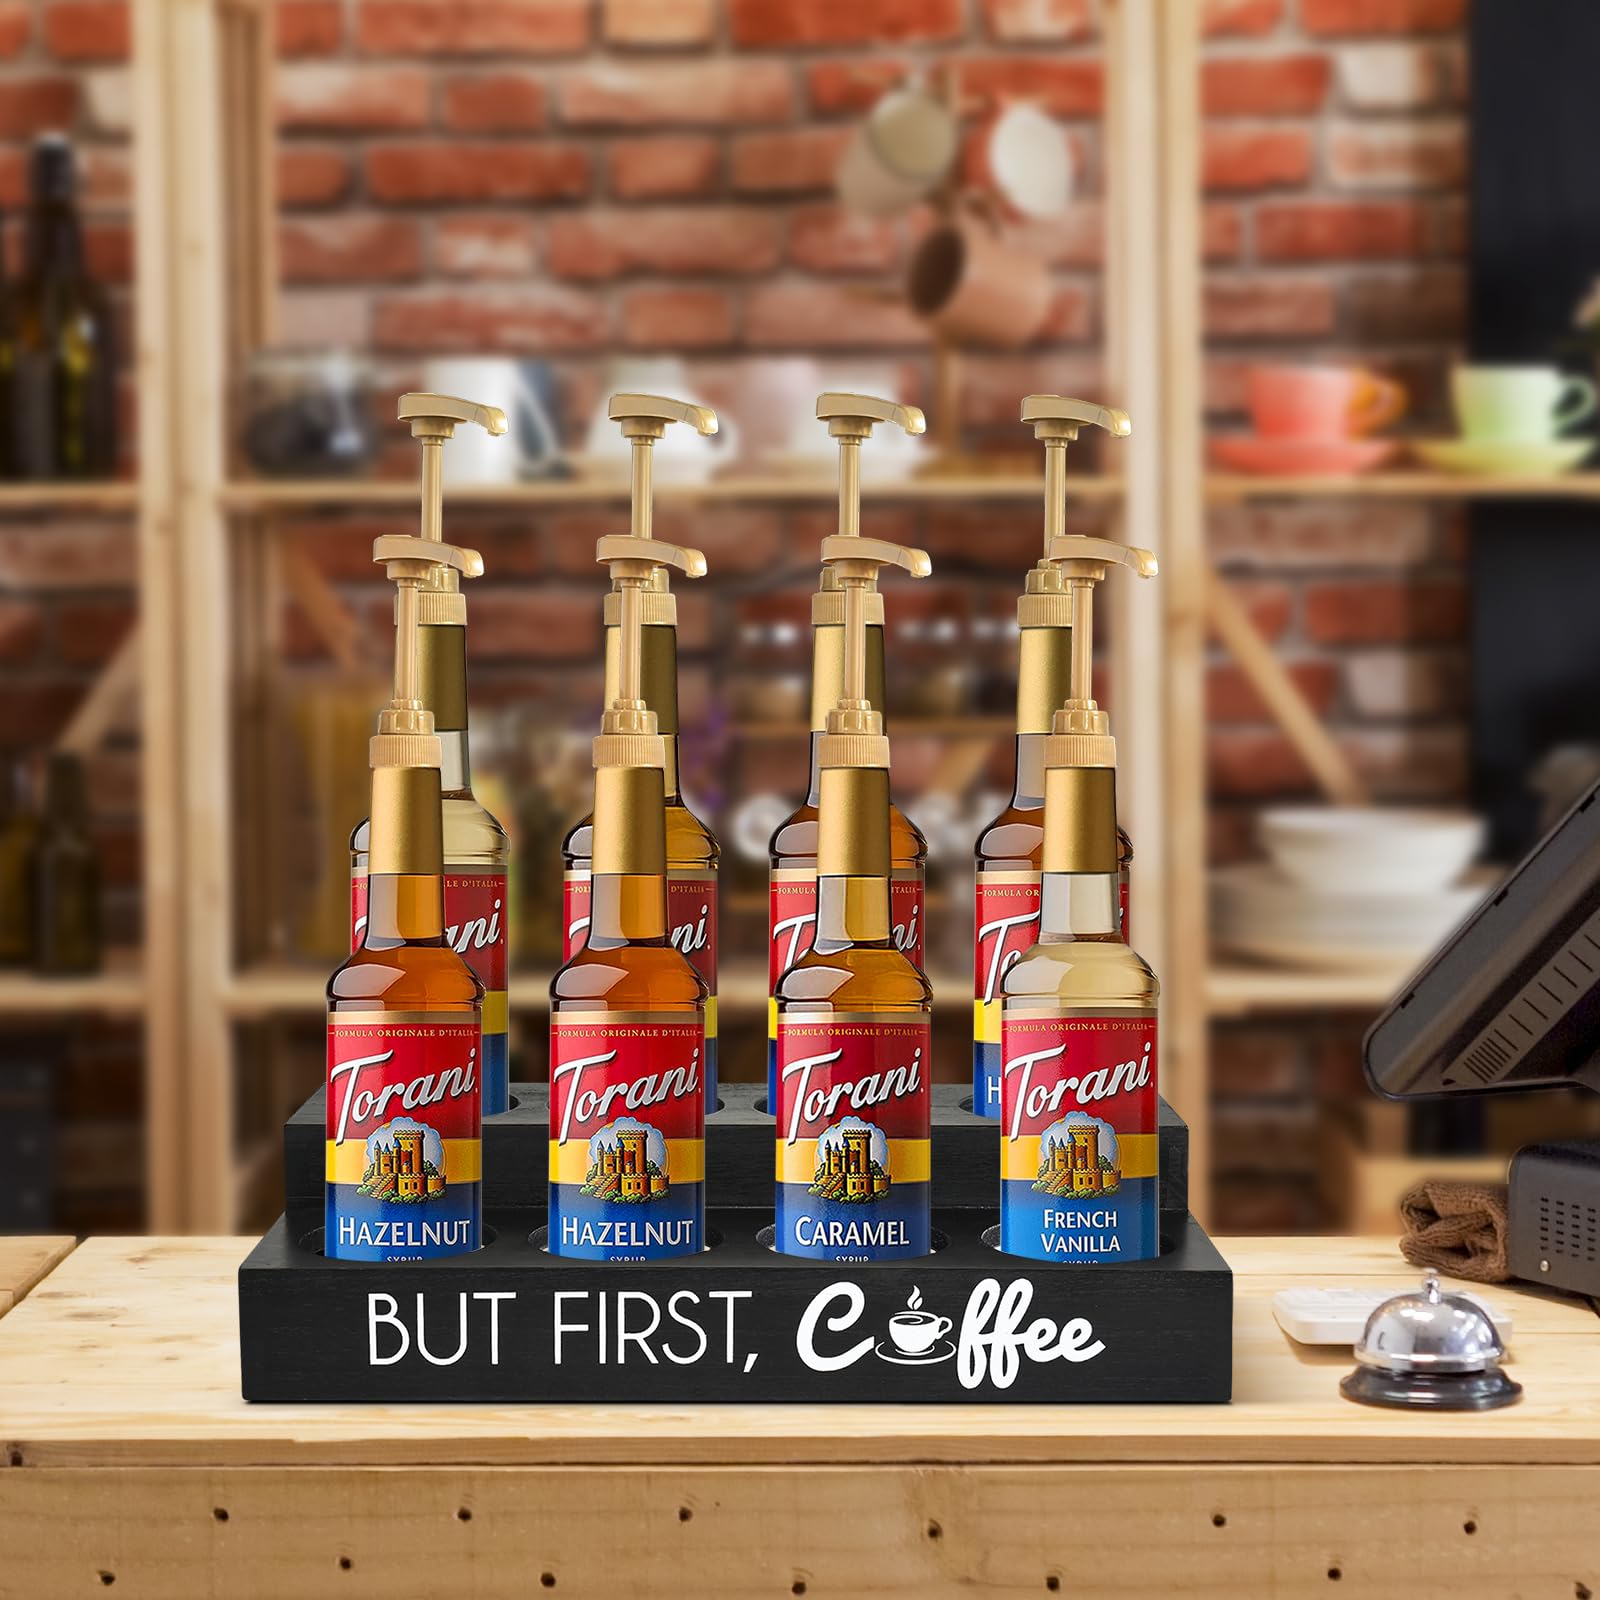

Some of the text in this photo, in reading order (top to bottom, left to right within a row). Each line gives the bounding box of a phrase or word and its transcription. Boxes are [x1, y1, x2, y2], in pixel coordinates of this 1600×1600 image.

[335, 1029, 374, 1037] FORMULA
[377, 1029, 436, 1037] ORIGINALE
[559, 1029, 597, 1037] FORMULA
[600, 1029, 659, 1037] ORIGINALE
[787, 1028, 824, 1036] FORMULA
[827, 1028, 881, 1036] ORIGINALE
[1008, 1024, 1046, 1032] FORMULA
[1050, 1023, 1108, 1031] ORIGINALE
[330, 1047, 476, 1146] Torani
[553, 1047, 699, 1146] Torani
[782, 1047, 922, 1146] Torani
[1004, 1041, 1151, 1142] Torani
[339, 1216, 470, 1246] HAZELNUT
[562, 1216, 694, 1246] HAZELNUT
[795, 1215, 910, 1247] CARAMEL
[1044, 1209, 1117, 1229] FRENCH
[1041, 1233, 1121, 1253] VANILLA
[368, 1278, 1106, 1390] BUT FIRST, Cffee
